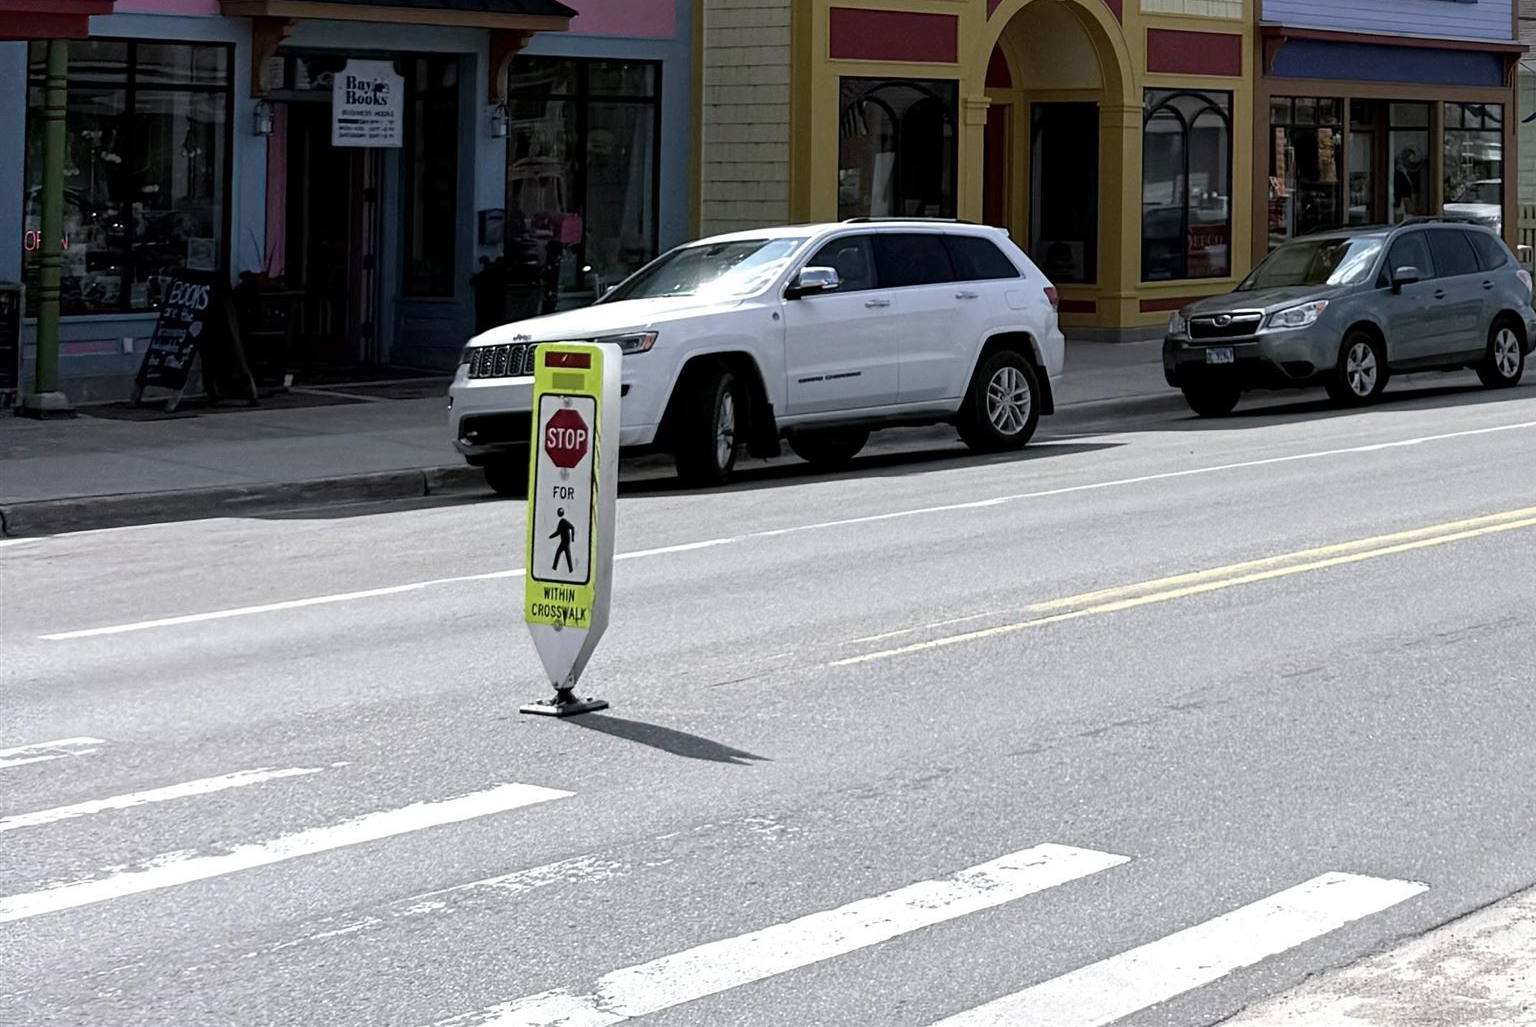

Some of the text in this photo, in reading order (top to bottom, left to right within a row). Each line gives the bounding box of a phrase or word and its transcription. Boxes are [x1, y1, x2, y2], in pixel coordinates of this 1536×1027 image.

[346, 75, 371, 94] Bay
[345, 90, 388, 105] Books
[168, 281, 211, 310] BOOKS
[547, 428, 586, 450] STOP
[553, 486, 575, 500] FOR
[543, 587, 575, 602] WITHIN
[531, 603, 587, 622] CROSSWALK
